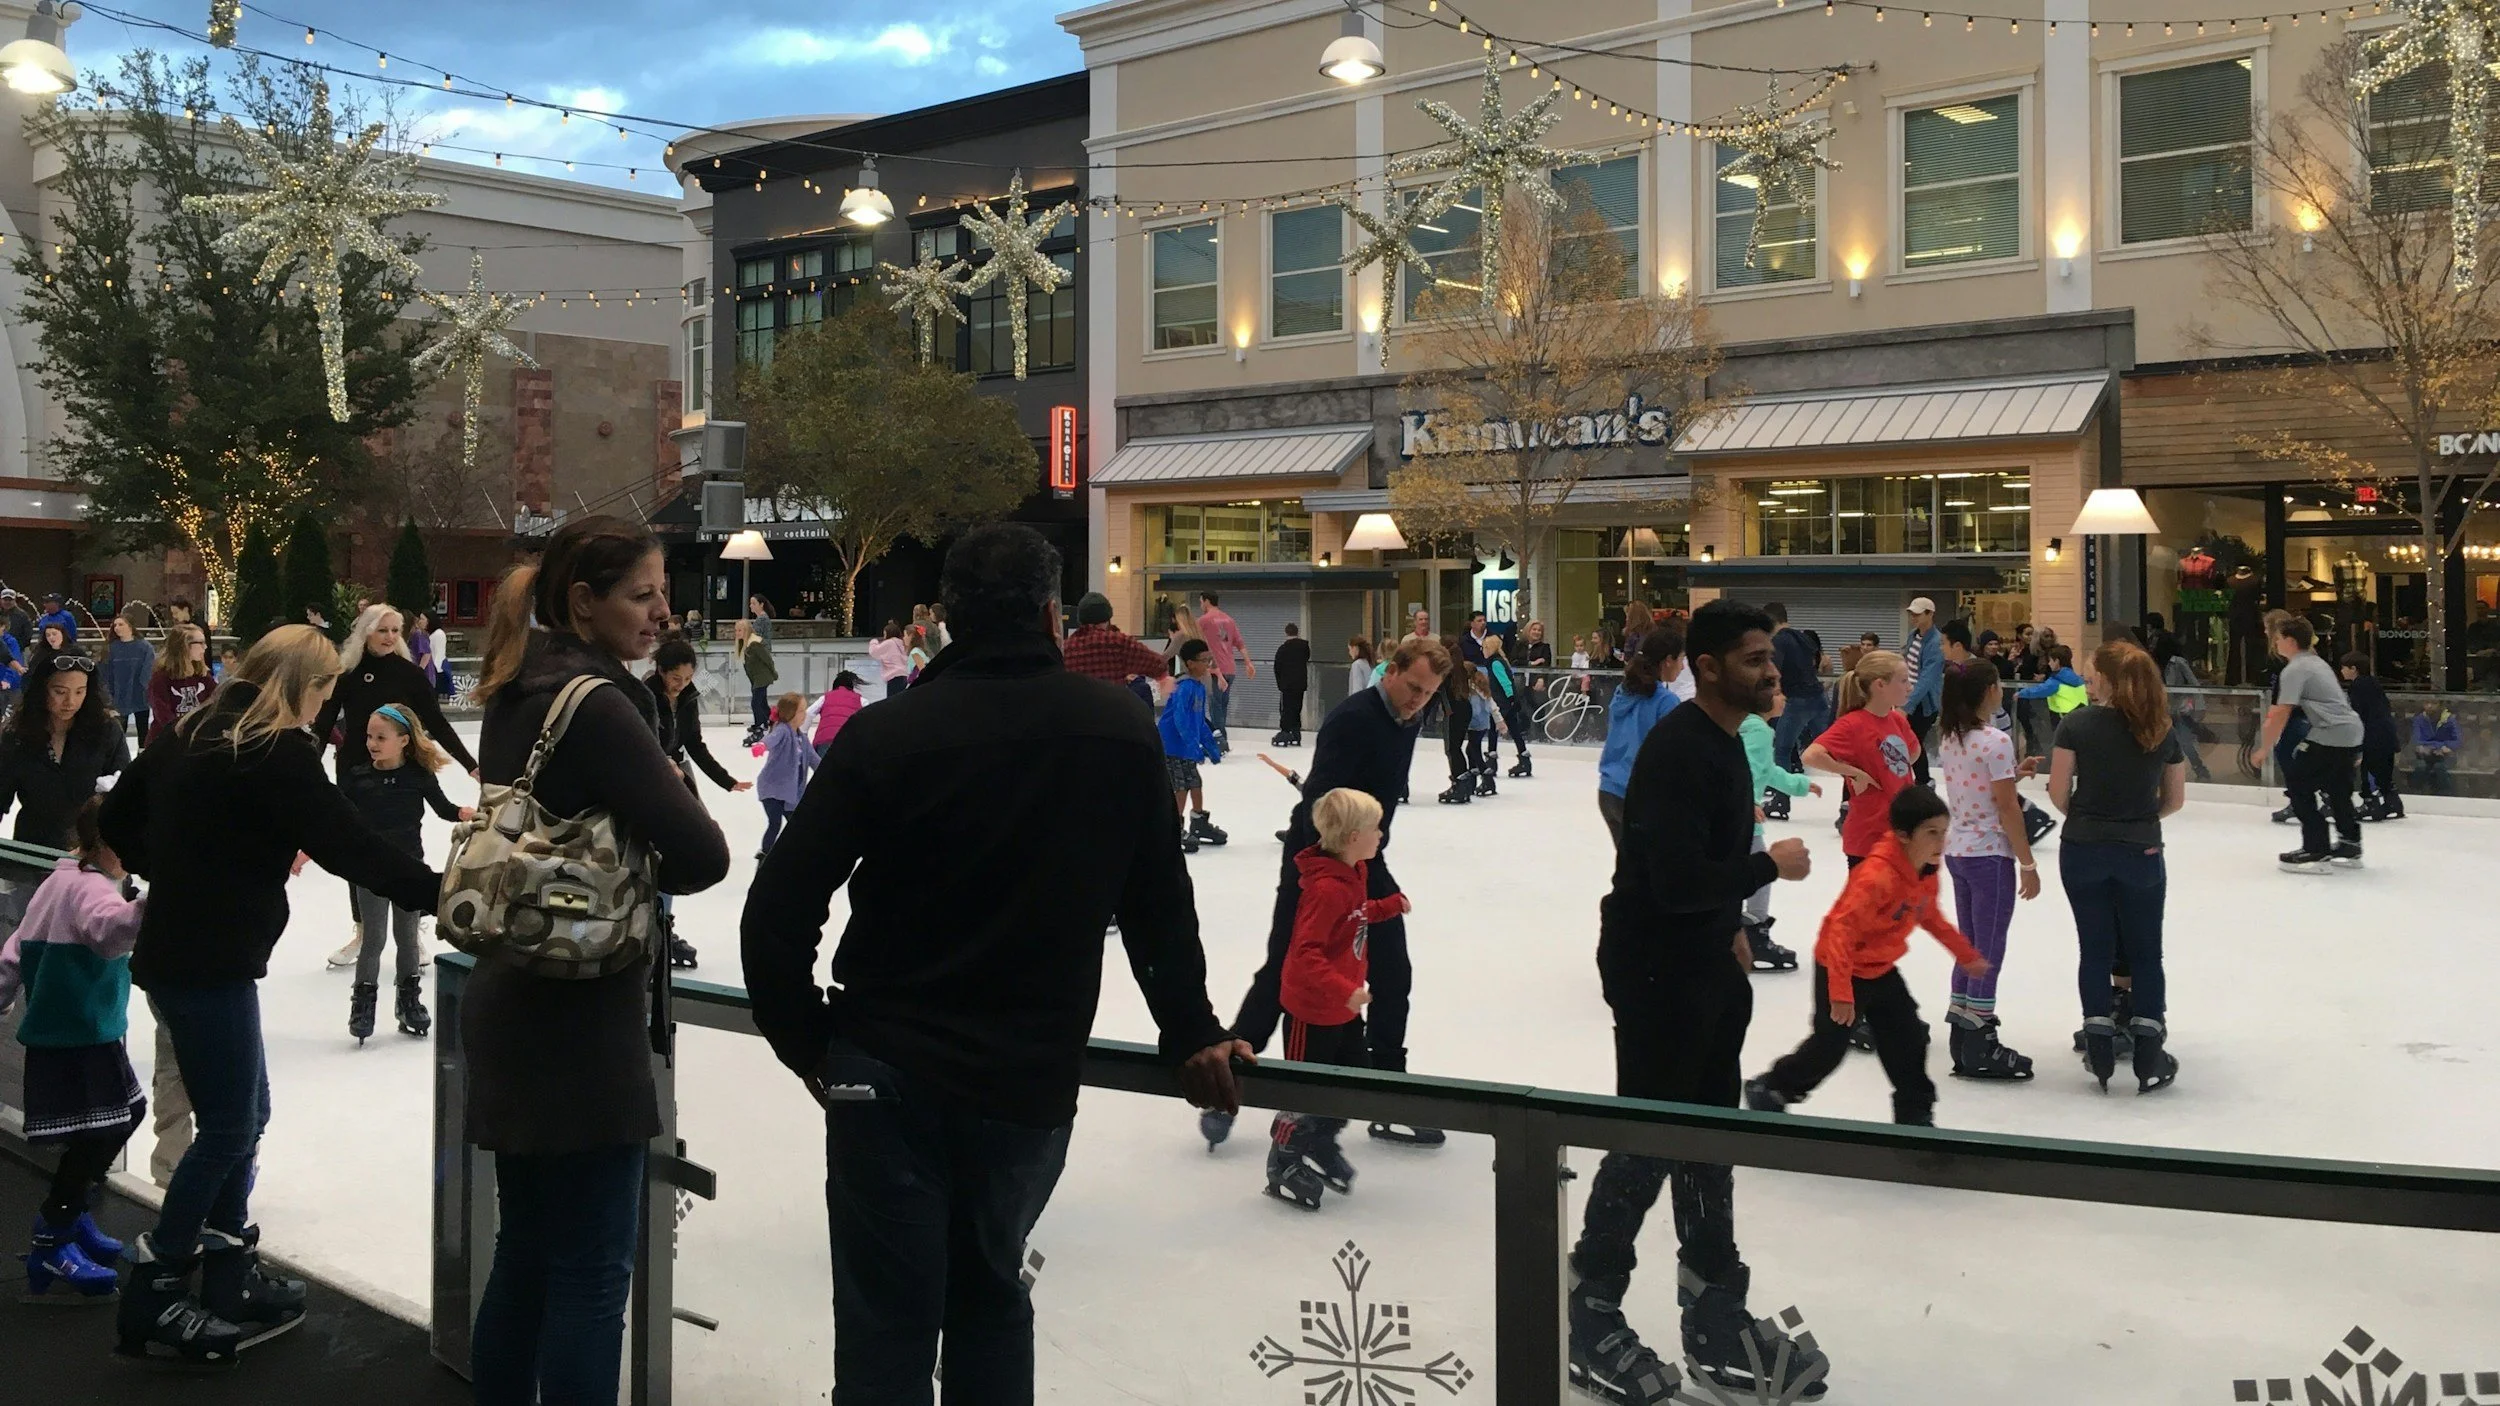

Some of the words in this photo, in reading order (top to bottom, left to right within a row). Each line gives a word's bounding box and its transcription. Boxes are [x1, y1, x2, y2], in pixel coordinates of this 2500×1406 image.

[1063, 410, 1072, 442] KONA
[2439, 432, 2500, 456] BON
[1063, 445, 1072, 485] GRILL
[784, 528, 830, 539] cocktails
[2379, 630, 2428, 639] BONOBO
[1532, 675, 1604, 742] Joy
